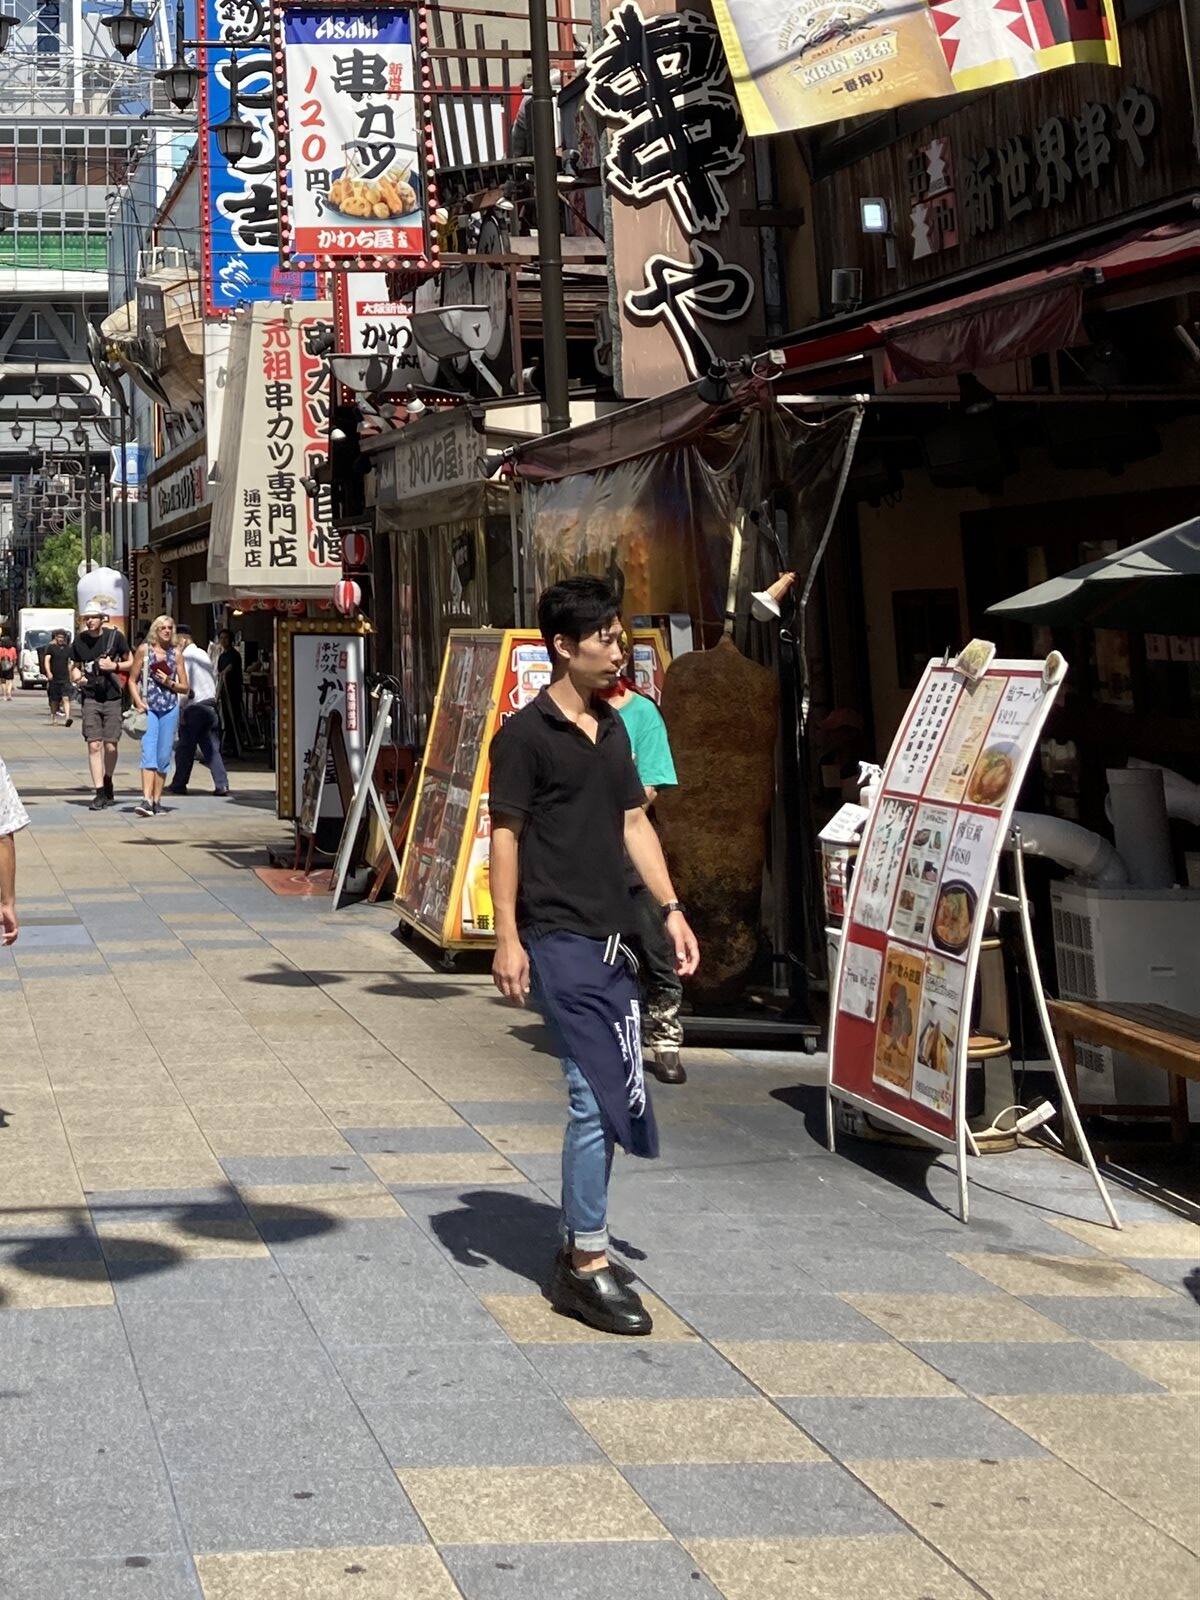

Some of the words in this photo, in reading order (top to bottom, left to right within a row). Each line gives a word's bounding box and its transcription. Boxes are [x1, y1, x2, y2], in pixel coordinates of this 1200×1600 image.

[802, 54, 849, 86] KIRIN
[854, 40, 894, 67] BEER
[832, 68, 884, 95] 一番搾り
[330, 47, 397, 181] 串カツ
[316, 229, 395, 249] かわち屋
[261, 317, 298, 568] 元祖串カツ専門店
[243, 488, 262, 568] 通天閣店
[462, 914, 495, 930] 一番
